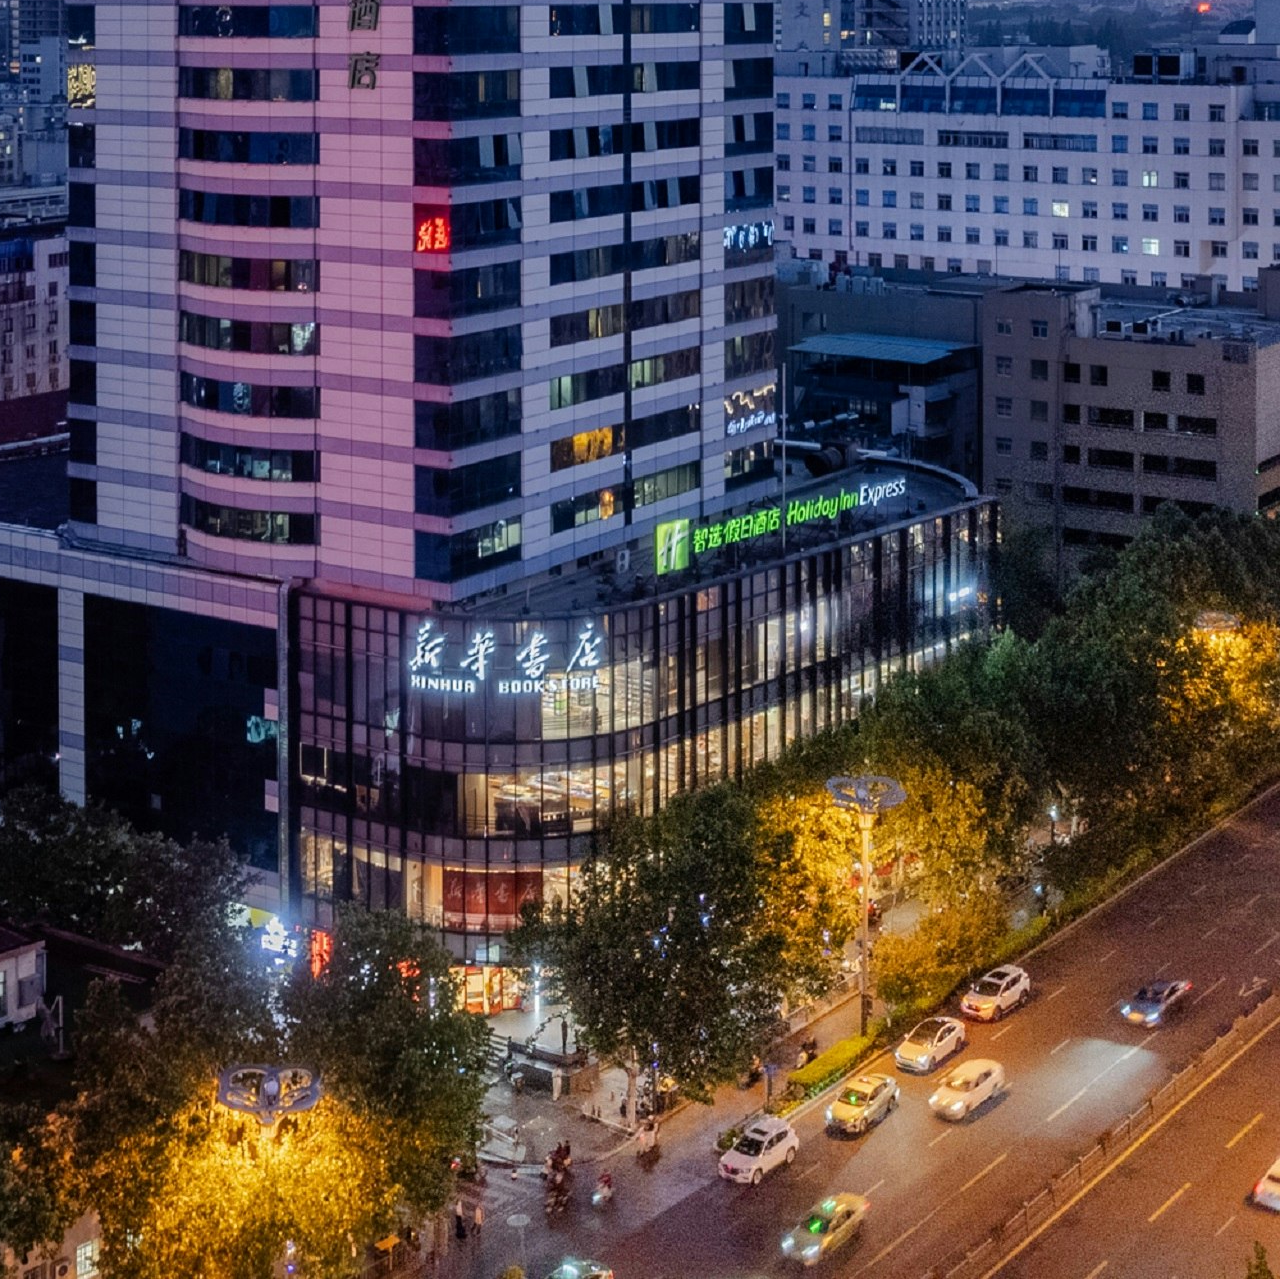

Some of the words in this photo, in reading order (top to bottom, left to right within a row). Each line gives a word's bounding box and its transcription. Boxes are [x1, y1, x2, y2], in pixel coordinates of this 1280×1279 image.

[694, 506, 781, 553] 智选假日酒店
[786, 495, 839, 526] Holiday
[840, 488, 859, 511] Inn
[860, 476, 906, 506] Express
[410, 674, 476, 693] XINHUA
